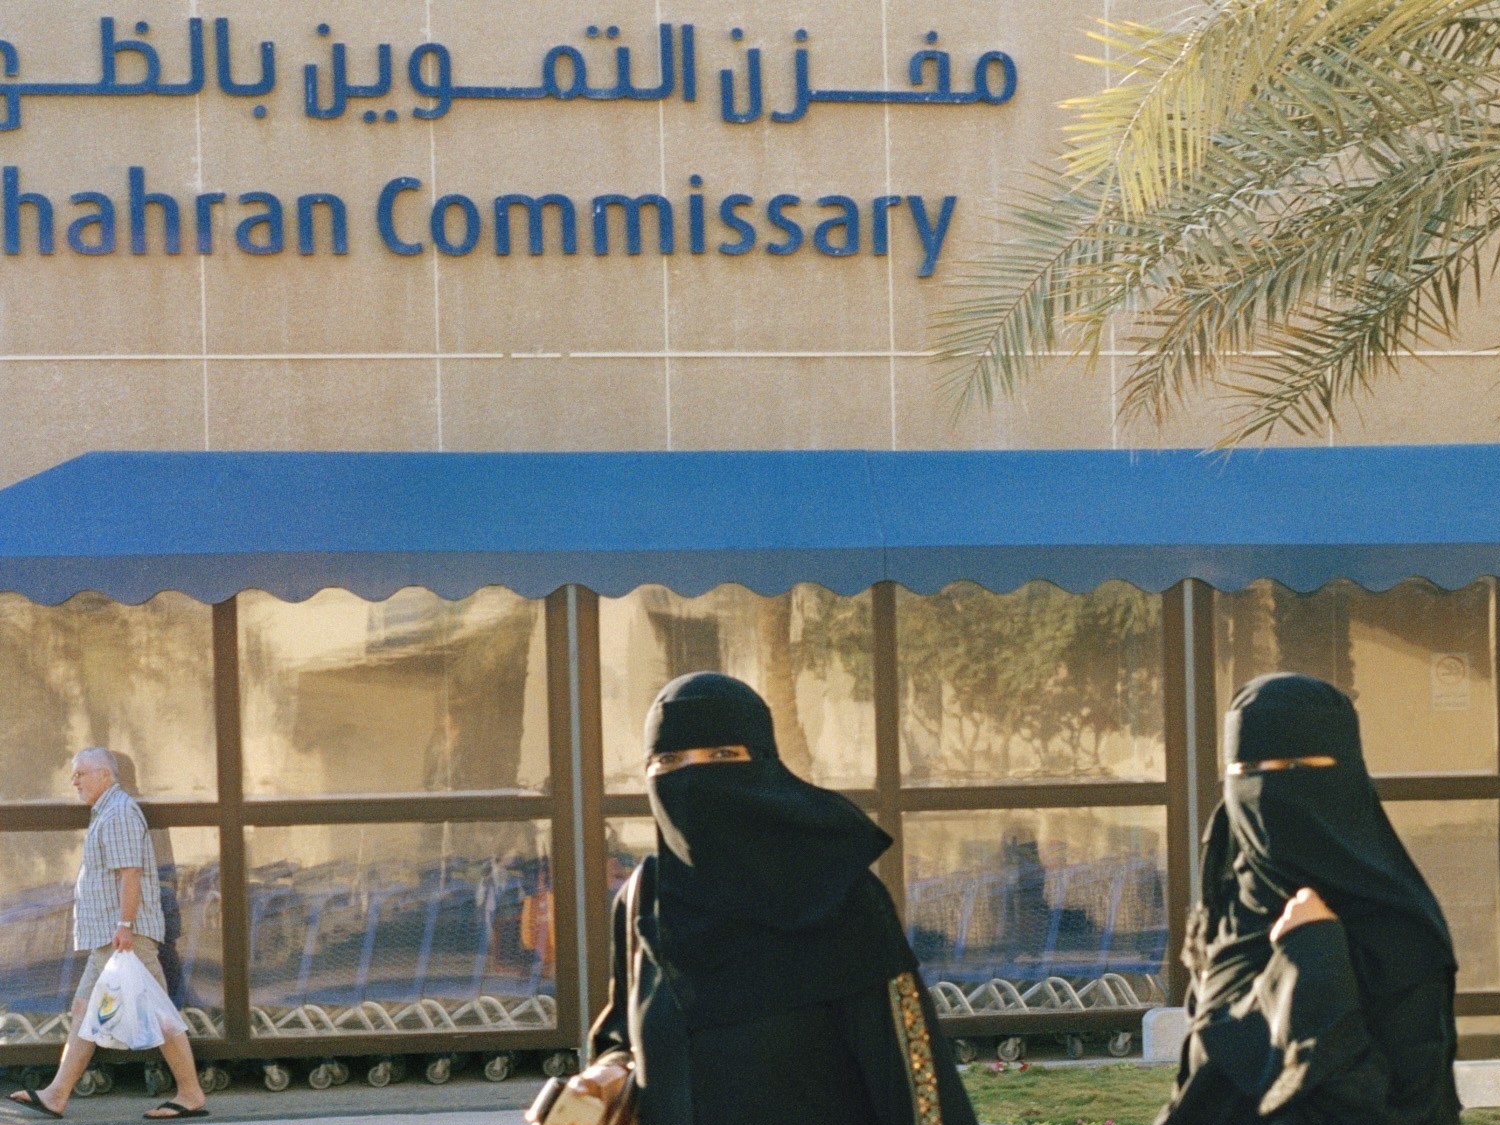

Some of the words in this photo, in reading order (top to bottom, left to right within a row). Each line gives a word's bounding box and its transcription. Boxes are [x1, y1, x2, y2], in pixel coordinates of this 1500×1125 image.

[304, 23, 696, 122] التموين
[719, 27, 1018, 123] مخزن
[2, 165, 348, 255] hahran
[376, 174, 957, 277] Commissary
